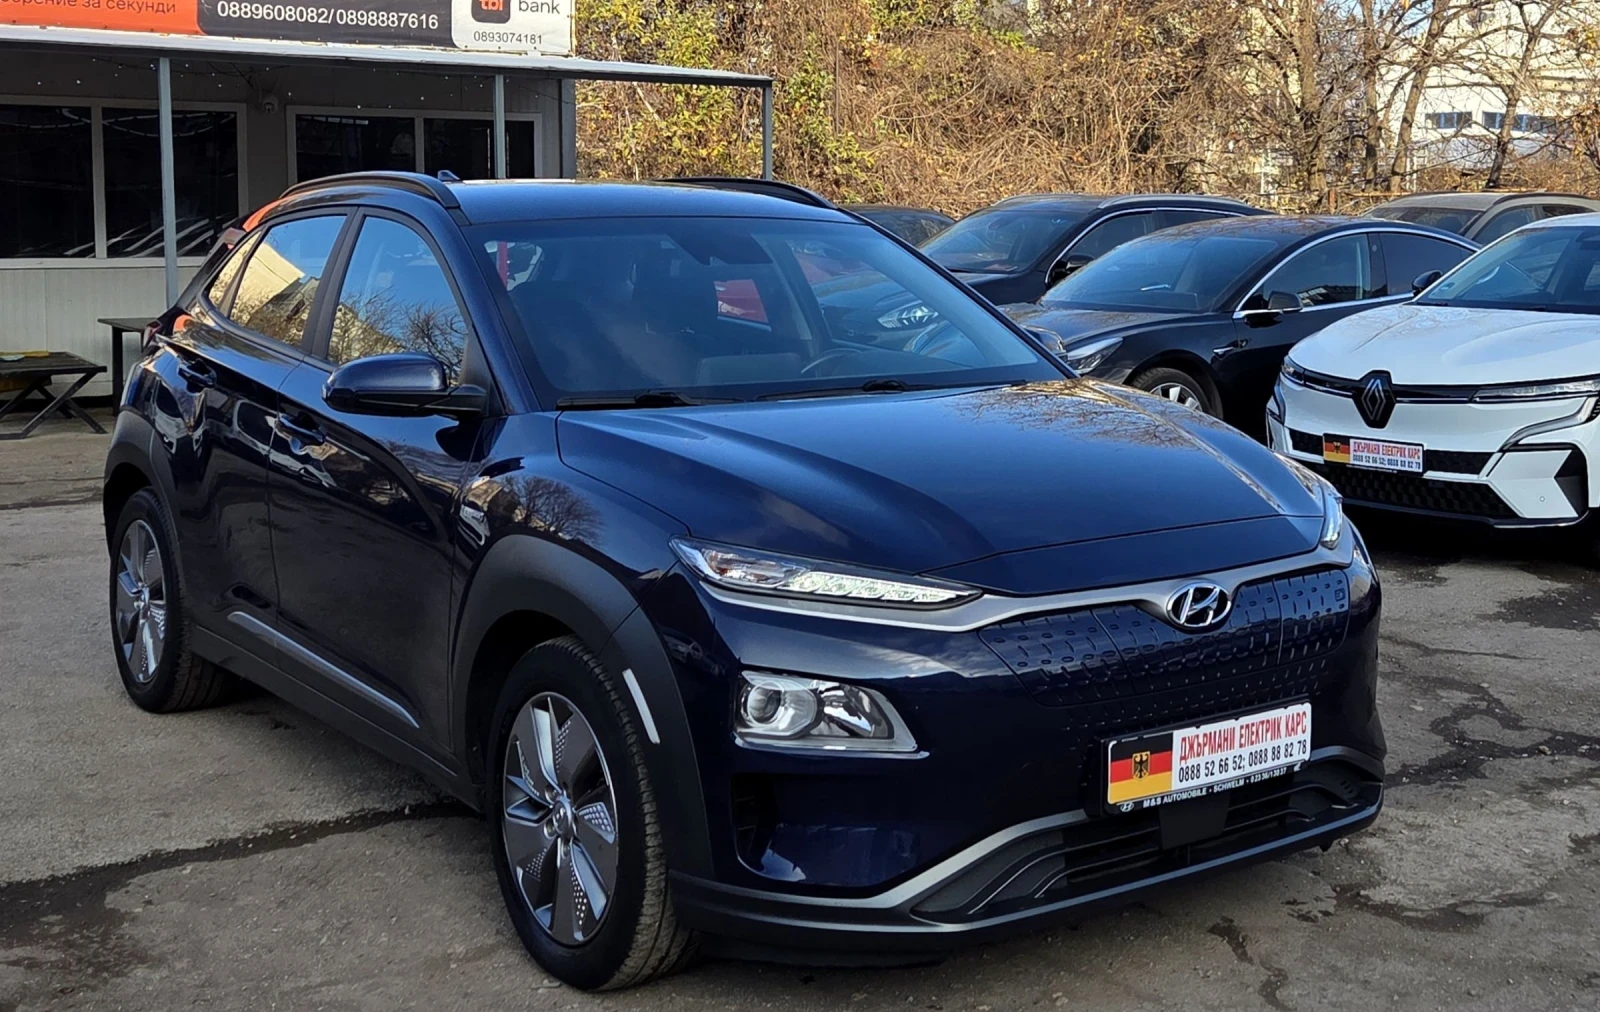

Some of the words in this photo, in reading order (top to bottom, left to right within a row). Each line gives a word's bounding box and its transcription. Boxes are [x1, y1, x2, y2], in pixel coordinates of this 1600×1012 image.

[82, 0, 101, 8] за
[106, 0, 176, 14] секунди
[217, 0, 439, 30] 0889608082/0898887616
[519, 0, 560, 14] bank
[473, 31, 542, 45] 0893074181
[1179, 727, 1236, 765] ДЖЪРМАНИ
[1239, 716, 1282, 749] ЕЛЕКТРИК
[1285, 711, 1307, 738] КАРС
[1178, 763, 1201, 783] 0888
[1204, 760, 1215, 778] 52
[1218, 757, 1229, 775] 66
[1232, 754, 1245, 772] 52;
[1248, 748, 1268, 767] 0888
[1271, 745, 1281, 762] 88
[1284, 742, 1294, 759] 82
[1297, 739, 1307, 756] 78
[1163, 788, 1207, 804] AUTOMOBILE
[1213, 779, 1244, 793] SCHWELM
